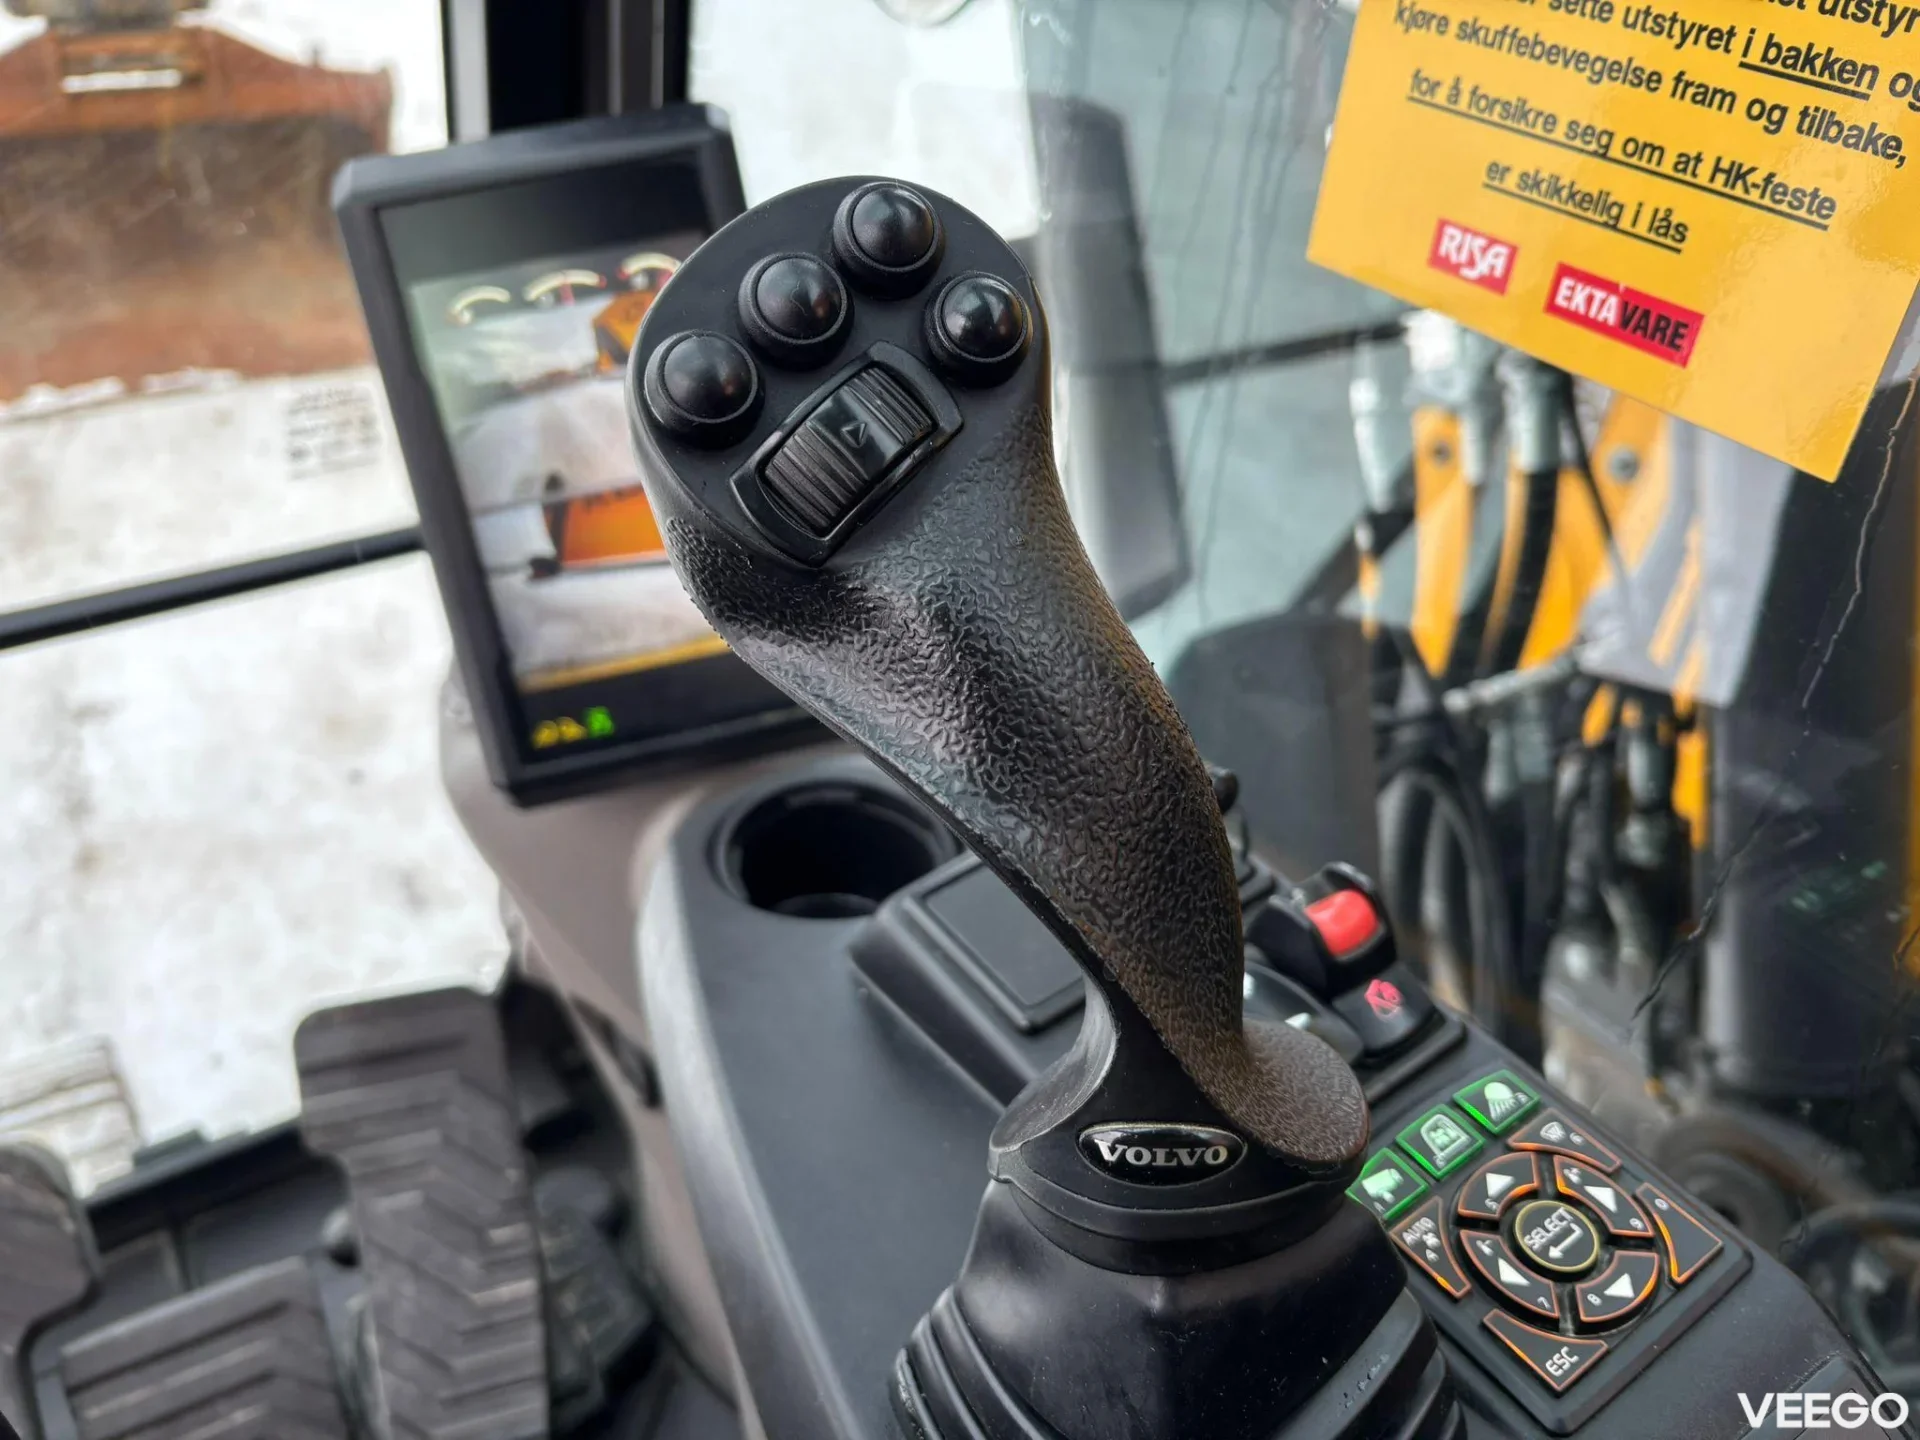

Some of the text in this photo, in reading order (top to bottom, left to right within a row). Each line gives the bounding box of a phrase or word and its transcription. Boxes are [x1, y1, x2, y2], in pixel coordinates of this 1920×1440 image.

[1622, 5, 1737, 54] utstyret
[1741, 28, 1756, 58] i
[1760, 33, 1880, 91] bakken
[1394, 1, 1907, 169] kjøre skuffebevegelse fram og tilbake,
[1410, 68, 1837, 220] for å forsikre seg om at HK-feste
[1486, 161, 1689, 244] er skikkelig i lås
[1437, 224, 1513, 281] RISA
[1094, 1138, 1228, 1166] VOLVO
[1402, 1217, 1436, 1246] AUTO
[1524, 1206, 1574, 1251] SELECT
[1545, 1346, 1579, 1377] ESC
